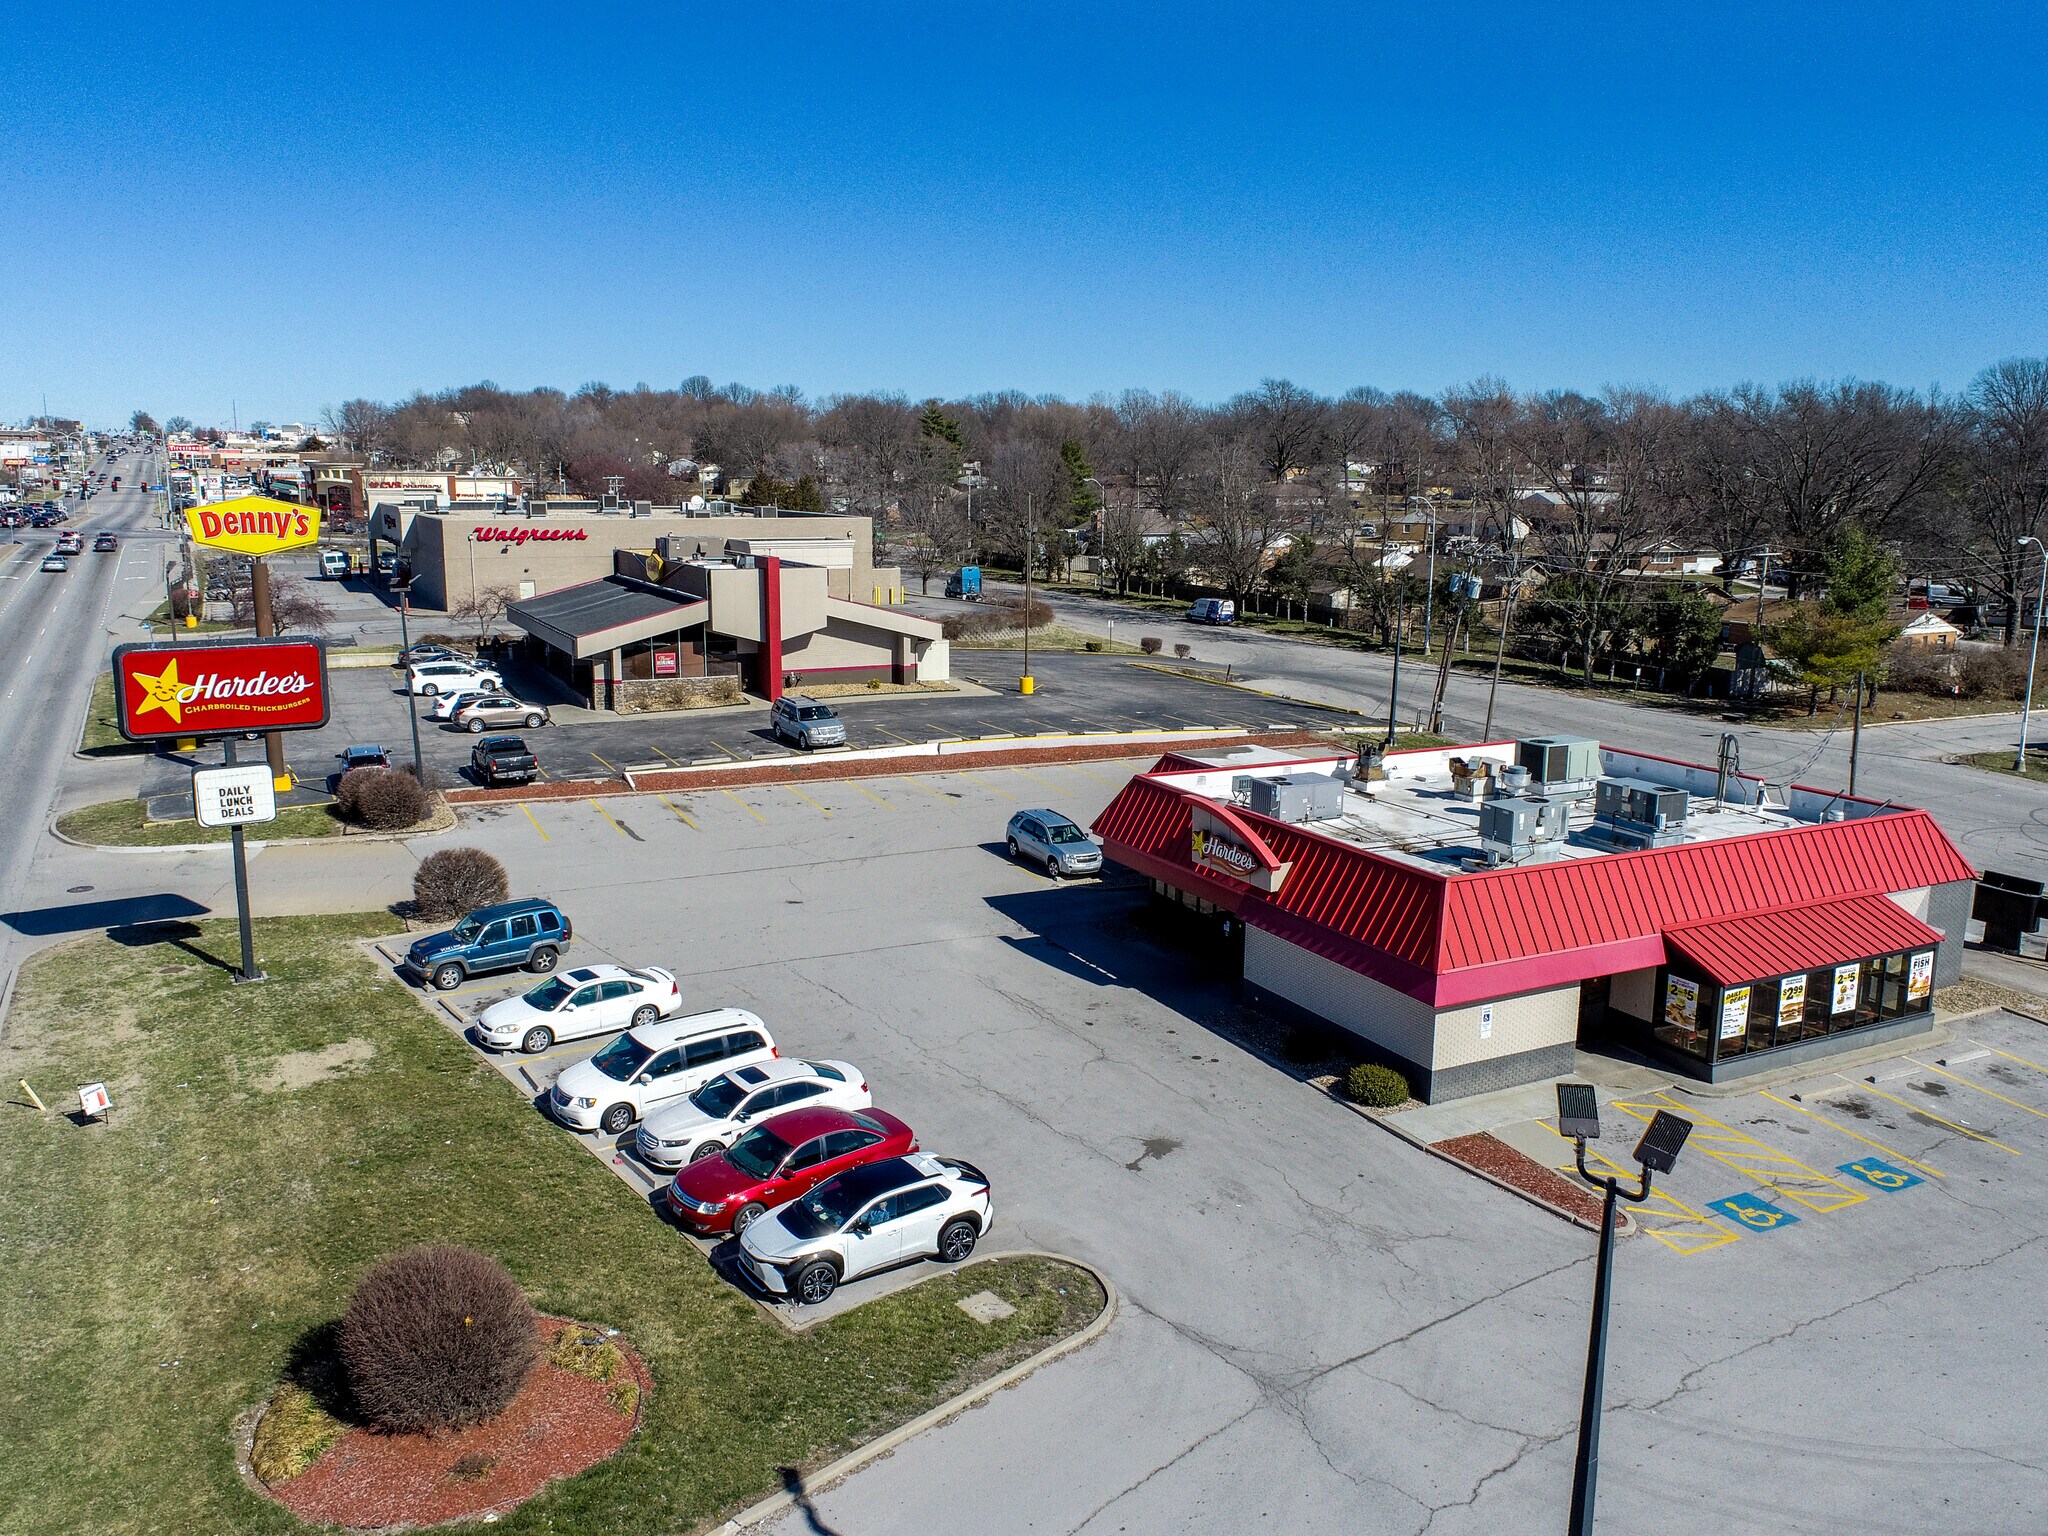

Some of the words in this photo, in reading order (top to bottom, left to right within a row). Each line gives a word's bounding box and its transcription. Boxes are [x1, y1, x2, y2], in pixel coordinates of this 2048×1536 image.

[380, 481, 402, 489] CVS
[198, 508, 310, 540] Denny's
[472, 526, 589, 546] Walgreens
[176, 671, 314, 704] Hardee's
[184, 703, 251, 714] CHARBROILED
[252, 697, 311, 712] THICKBURGERS
[219, 785, 251, 797] DAILY
[220, 796, 253, 808] LUNCH
[221, 807, 254, 818] DEALS
[1202, 837, 1256, 870] Hardee's
[1913, 957, 1930, 969] FISH
[1837, 974, 1844, 985] 2
[1670, 984, 1679, 996] 2
[1726, 990, 1743, 999] DAILY
[1730, 993, 1748, 1004] DEALS
